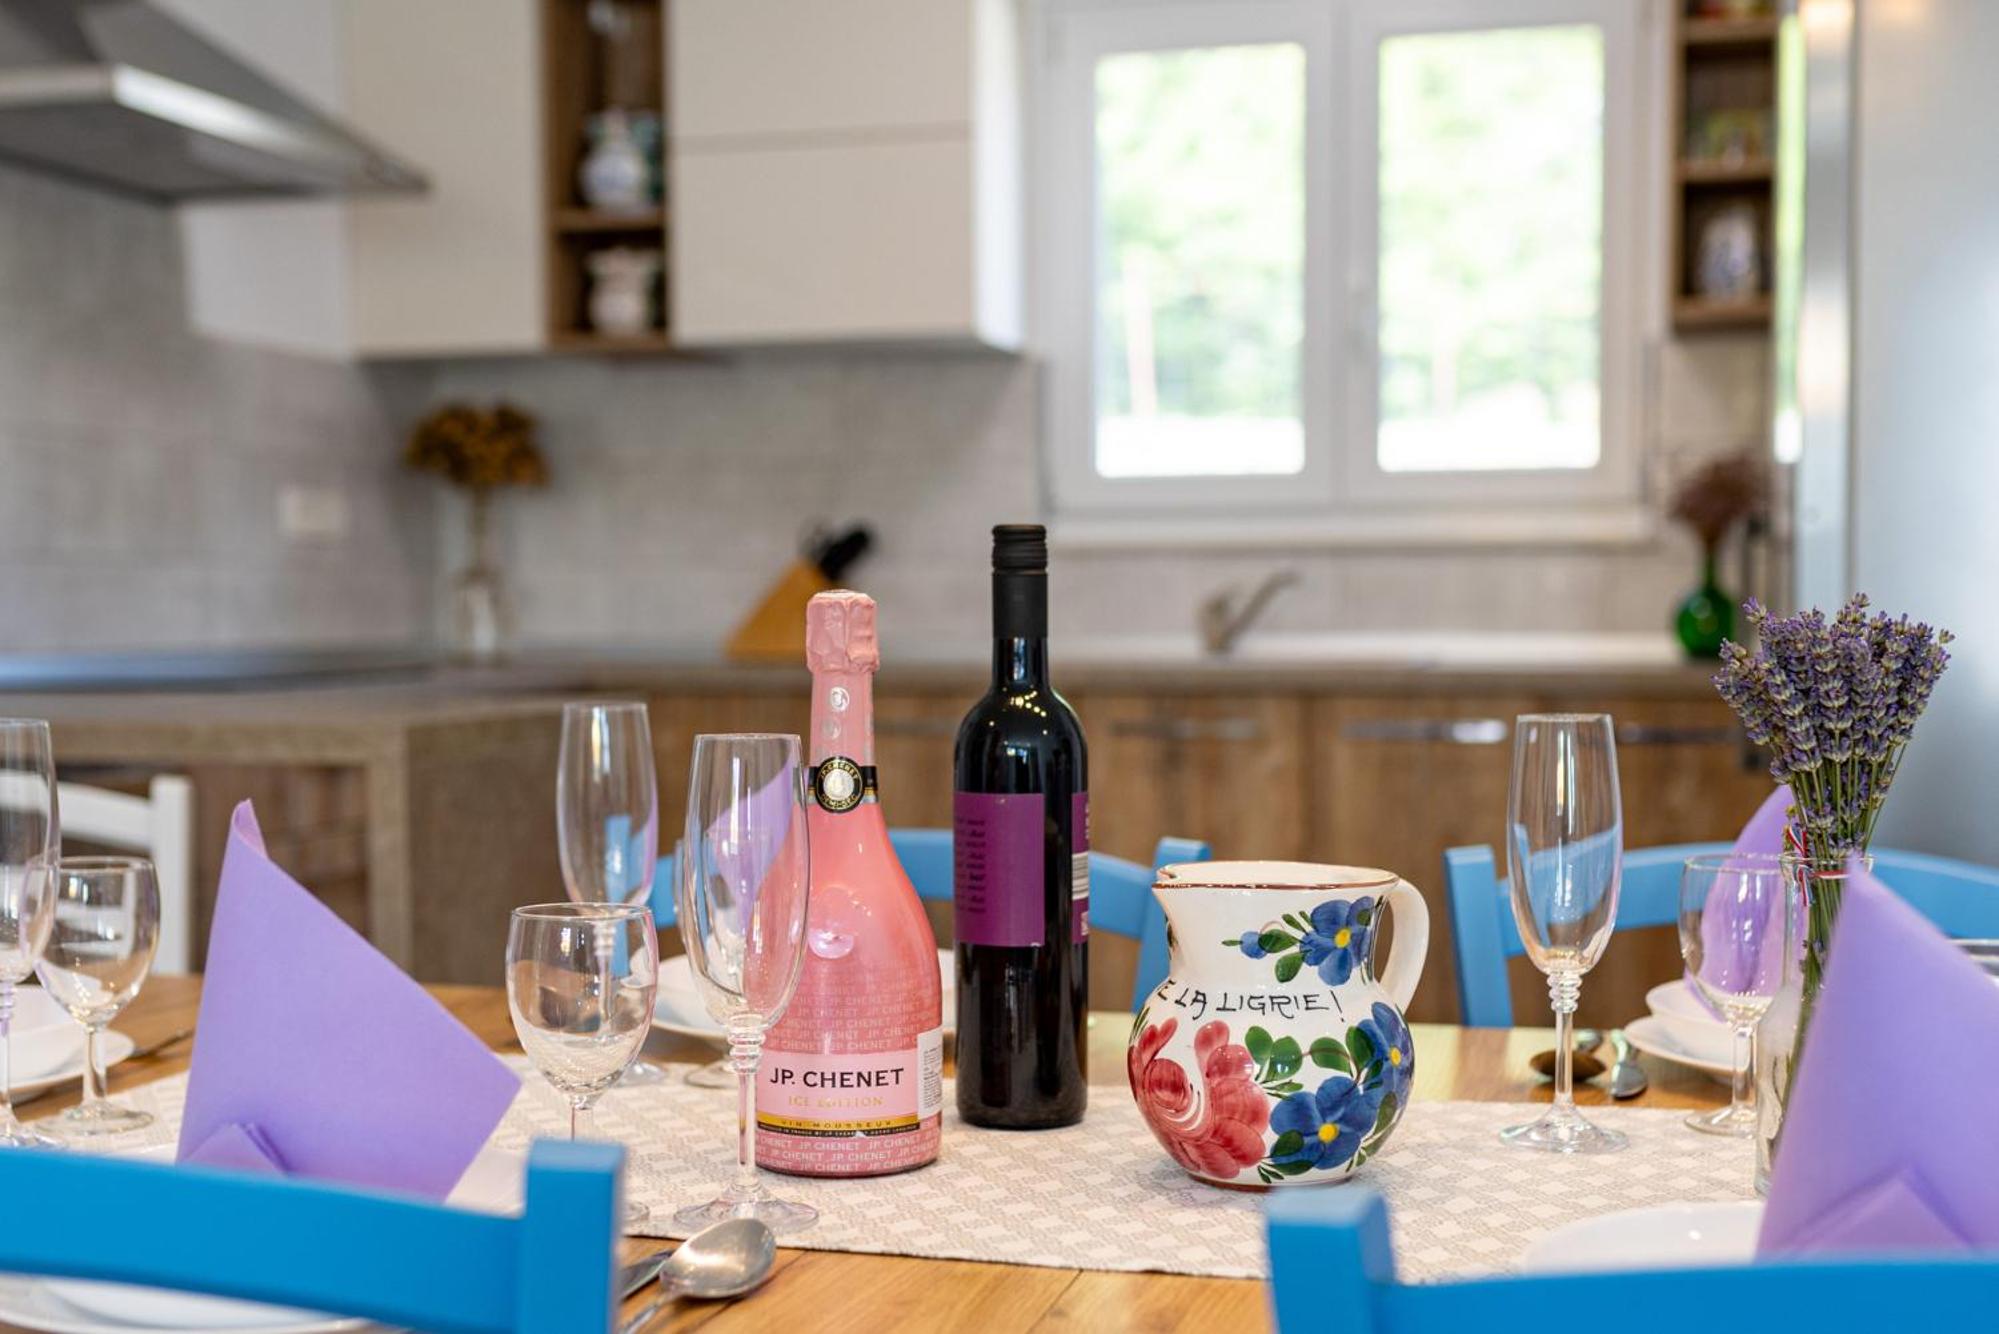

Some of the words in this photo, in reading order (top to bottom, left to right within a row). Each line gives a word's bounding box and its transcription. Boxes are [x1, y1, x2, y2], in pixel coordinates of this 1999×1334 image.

[770, 1067, 796, 1086] JP.
[803, 1067, 905, 1089] CHENET
[788, 1095, 810, 1108] ICE
